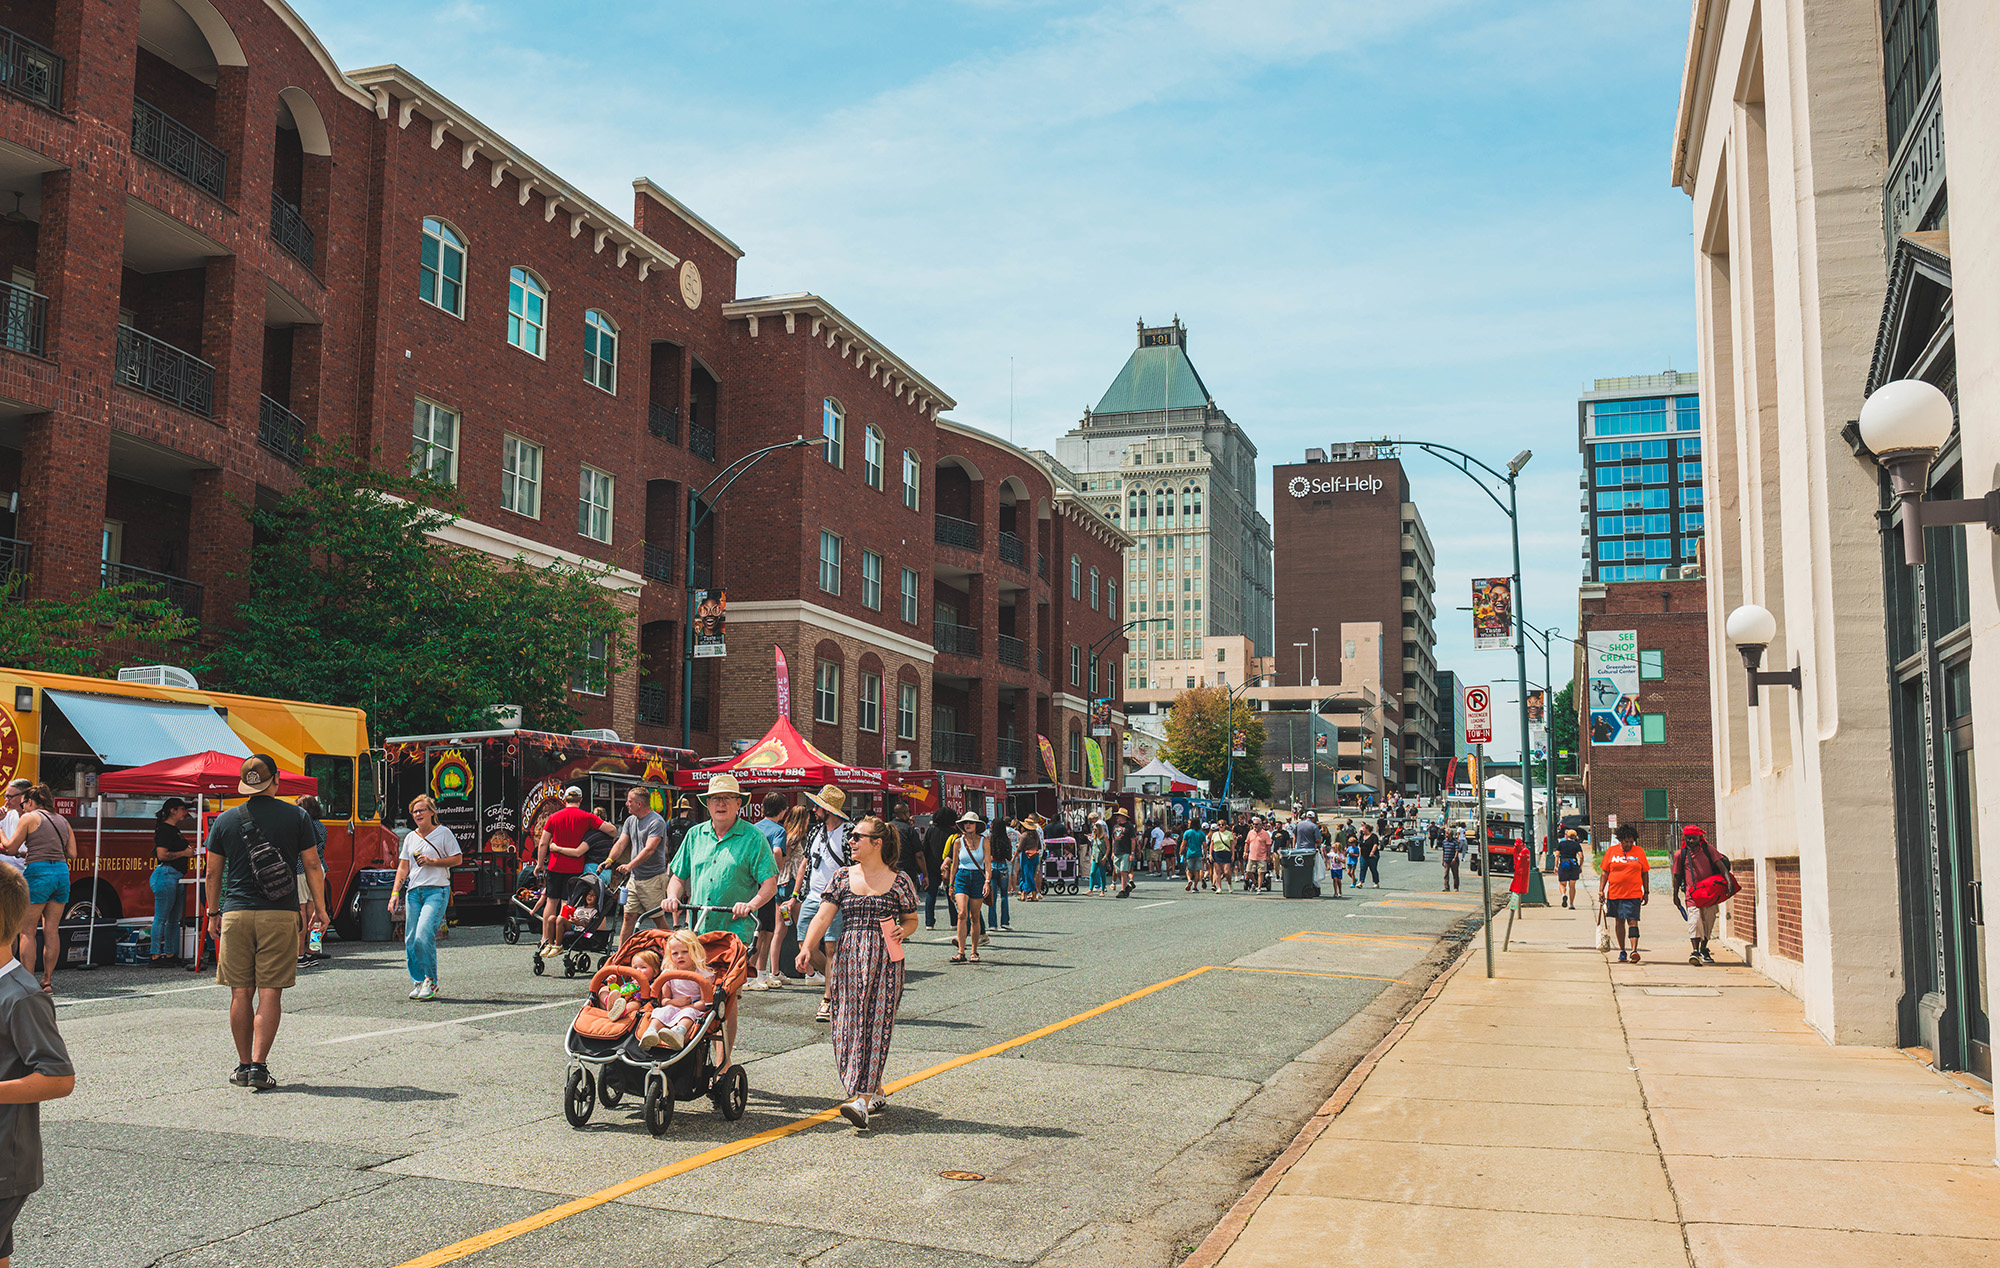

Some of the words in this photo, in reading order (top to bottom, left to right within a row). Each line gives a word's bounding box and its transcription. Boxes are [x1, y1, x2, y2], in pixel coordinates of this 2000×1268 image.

[1903, 106, 1944, 217] FRUIT
[1311, 474, 1383, 495] Self-Help
[1618, 633, 1635, 641] SEE
[1609, 643, 1635, 652] SHOP
[1600, 653, 1635, 662] CREATE
[1468, 729, 1490, 738] TOW-IN
[728, 768, 749, 777] Tree
[750, 768, 784, 778] Turkey
[785, 767, 806, 777] BBQ
[487, 807, 514, 817] CRACK
[522, 789, 544, 829] CRACK
[485, 822, 516, 833] CHEESE
[97, 857, 143, 871] STREETSIDE
